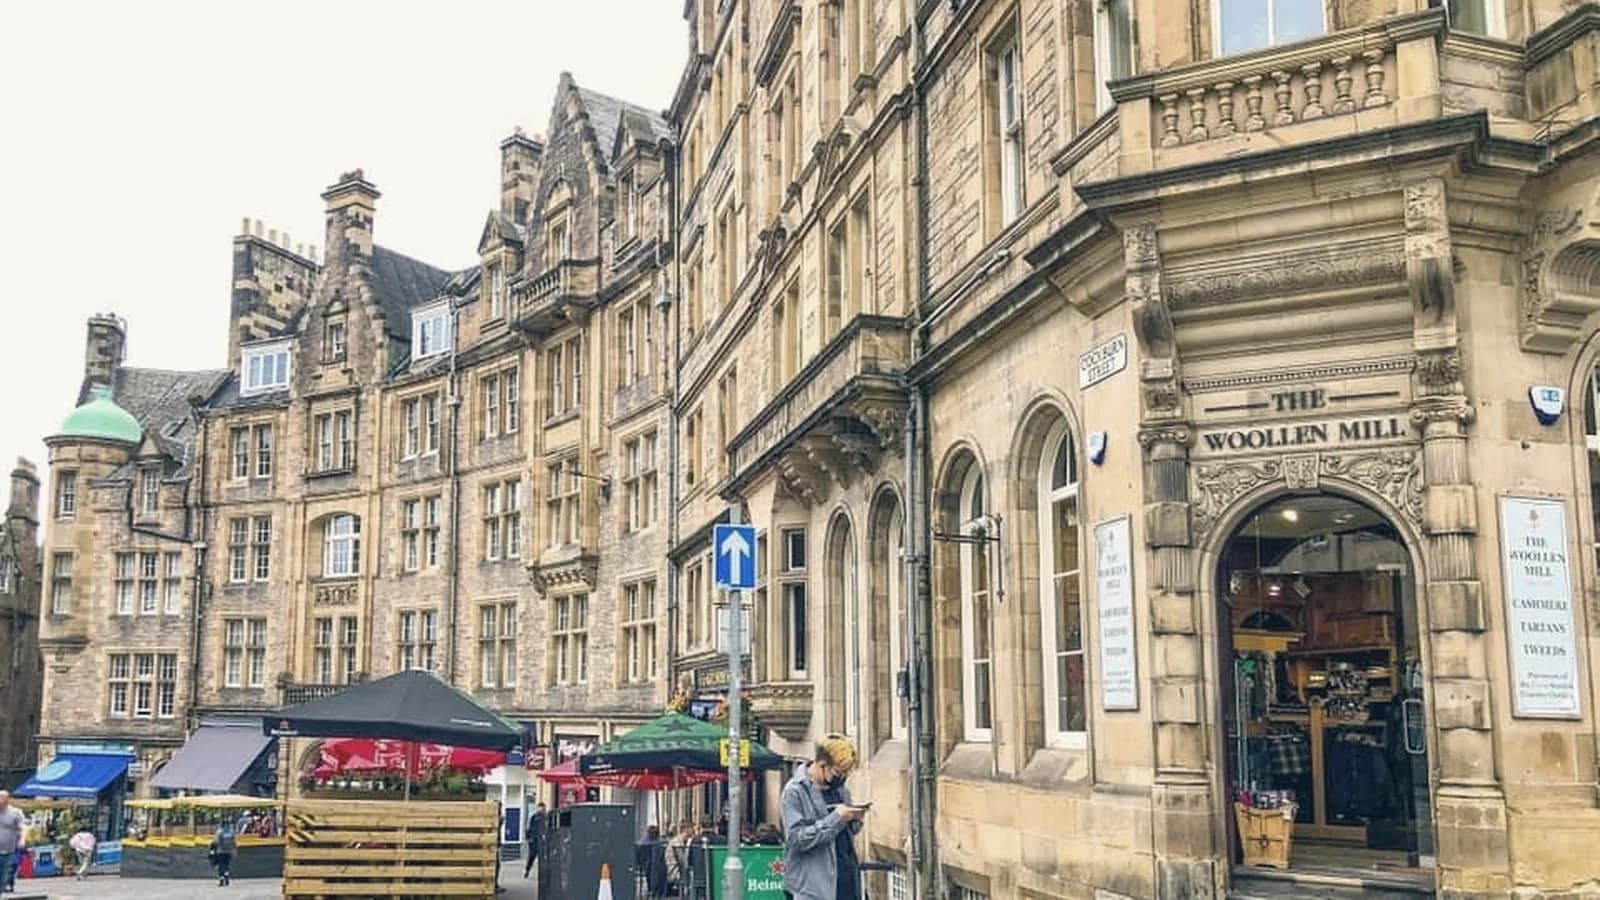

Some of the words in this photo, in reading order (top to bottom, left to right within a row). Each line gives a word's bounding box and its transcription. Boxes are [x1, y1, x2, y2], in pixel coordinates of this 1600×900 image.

[1271, 389, 1326, 412] THE
[1203, 423, 1328, 451] WOOLLEN
[1339, 418, 1406, 441] MILL
[1525, 536, 1548, 548] THE
[1509, 549, 1566, 564] WOOLLEN
[1524, 565, 1552, 577] MILL
[1523, 643, 1567, 656] TWEEDS
[747, 877, 784, 892] Heine
